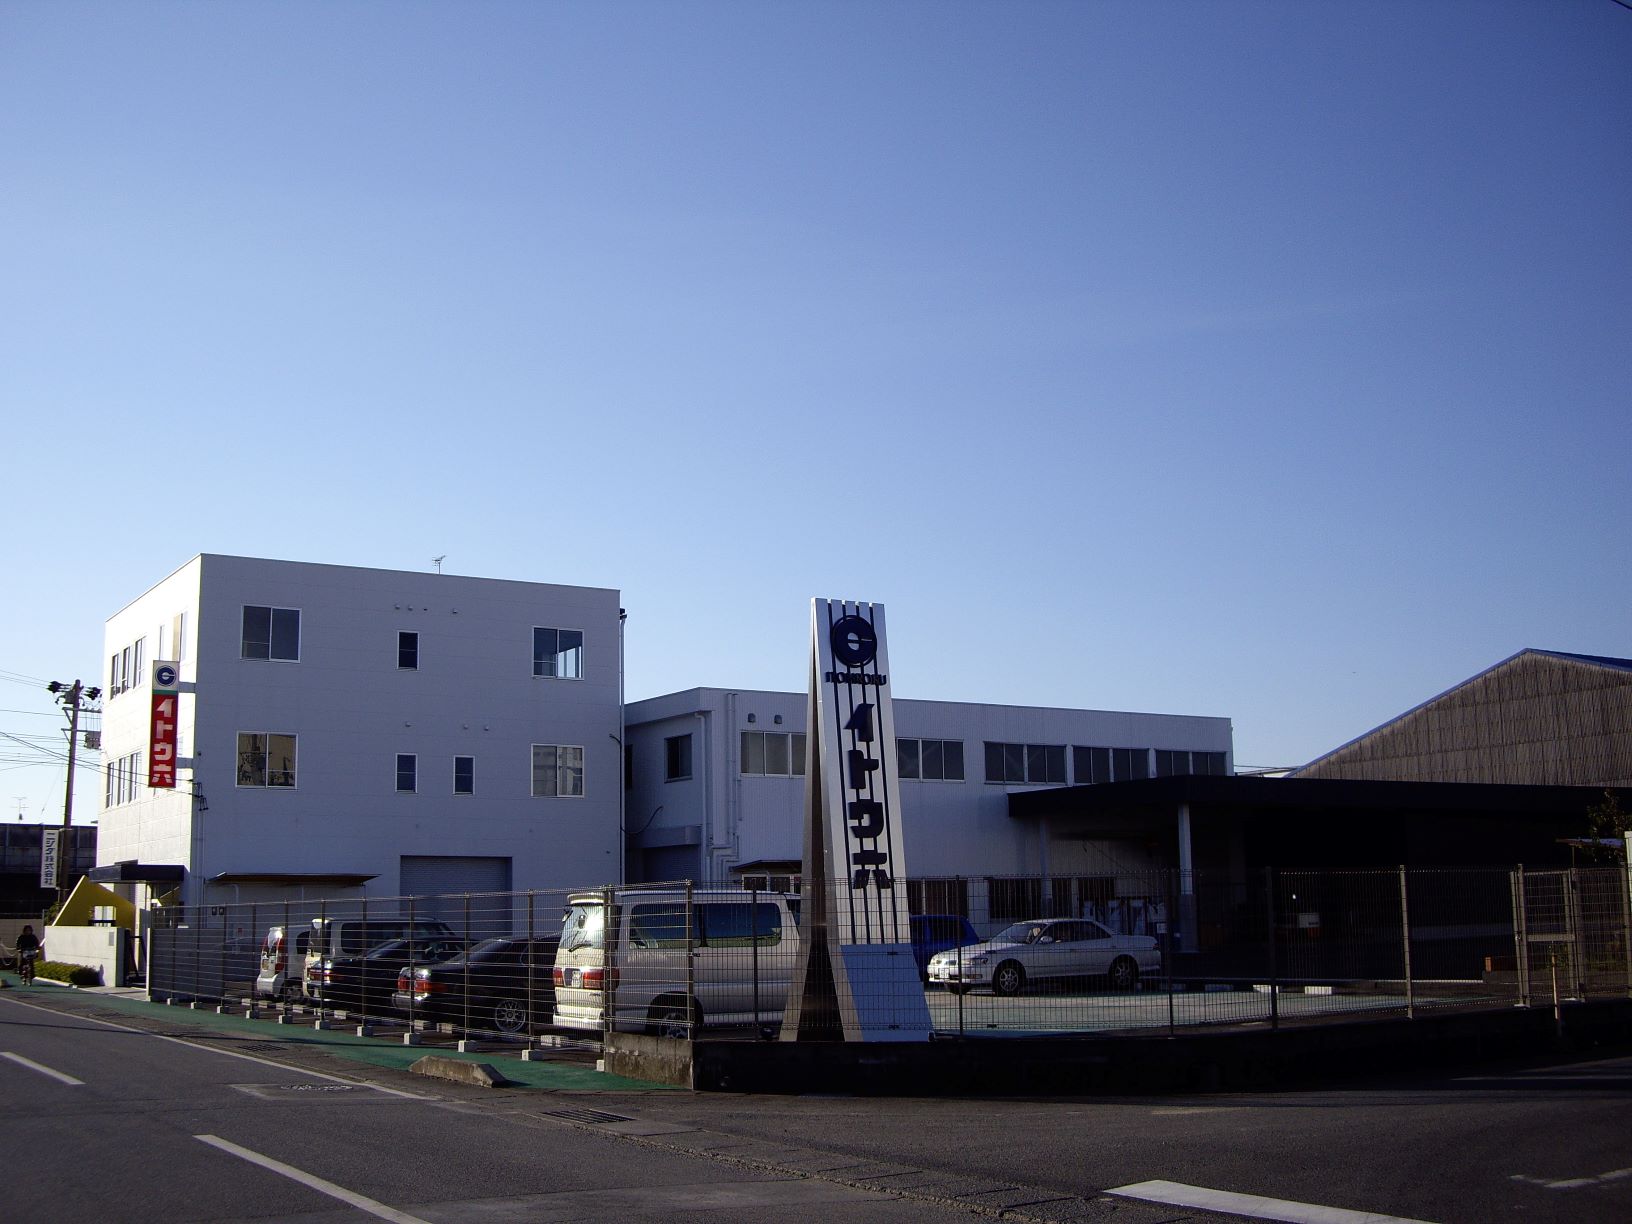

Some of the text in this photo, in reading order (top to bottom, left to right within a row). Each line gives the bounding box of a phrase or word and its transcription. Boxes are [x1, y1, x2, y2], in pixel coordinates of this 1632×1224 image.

[152, 698, 173, 784] イトウ六
[844, 703, 892, 890] イトウ六
